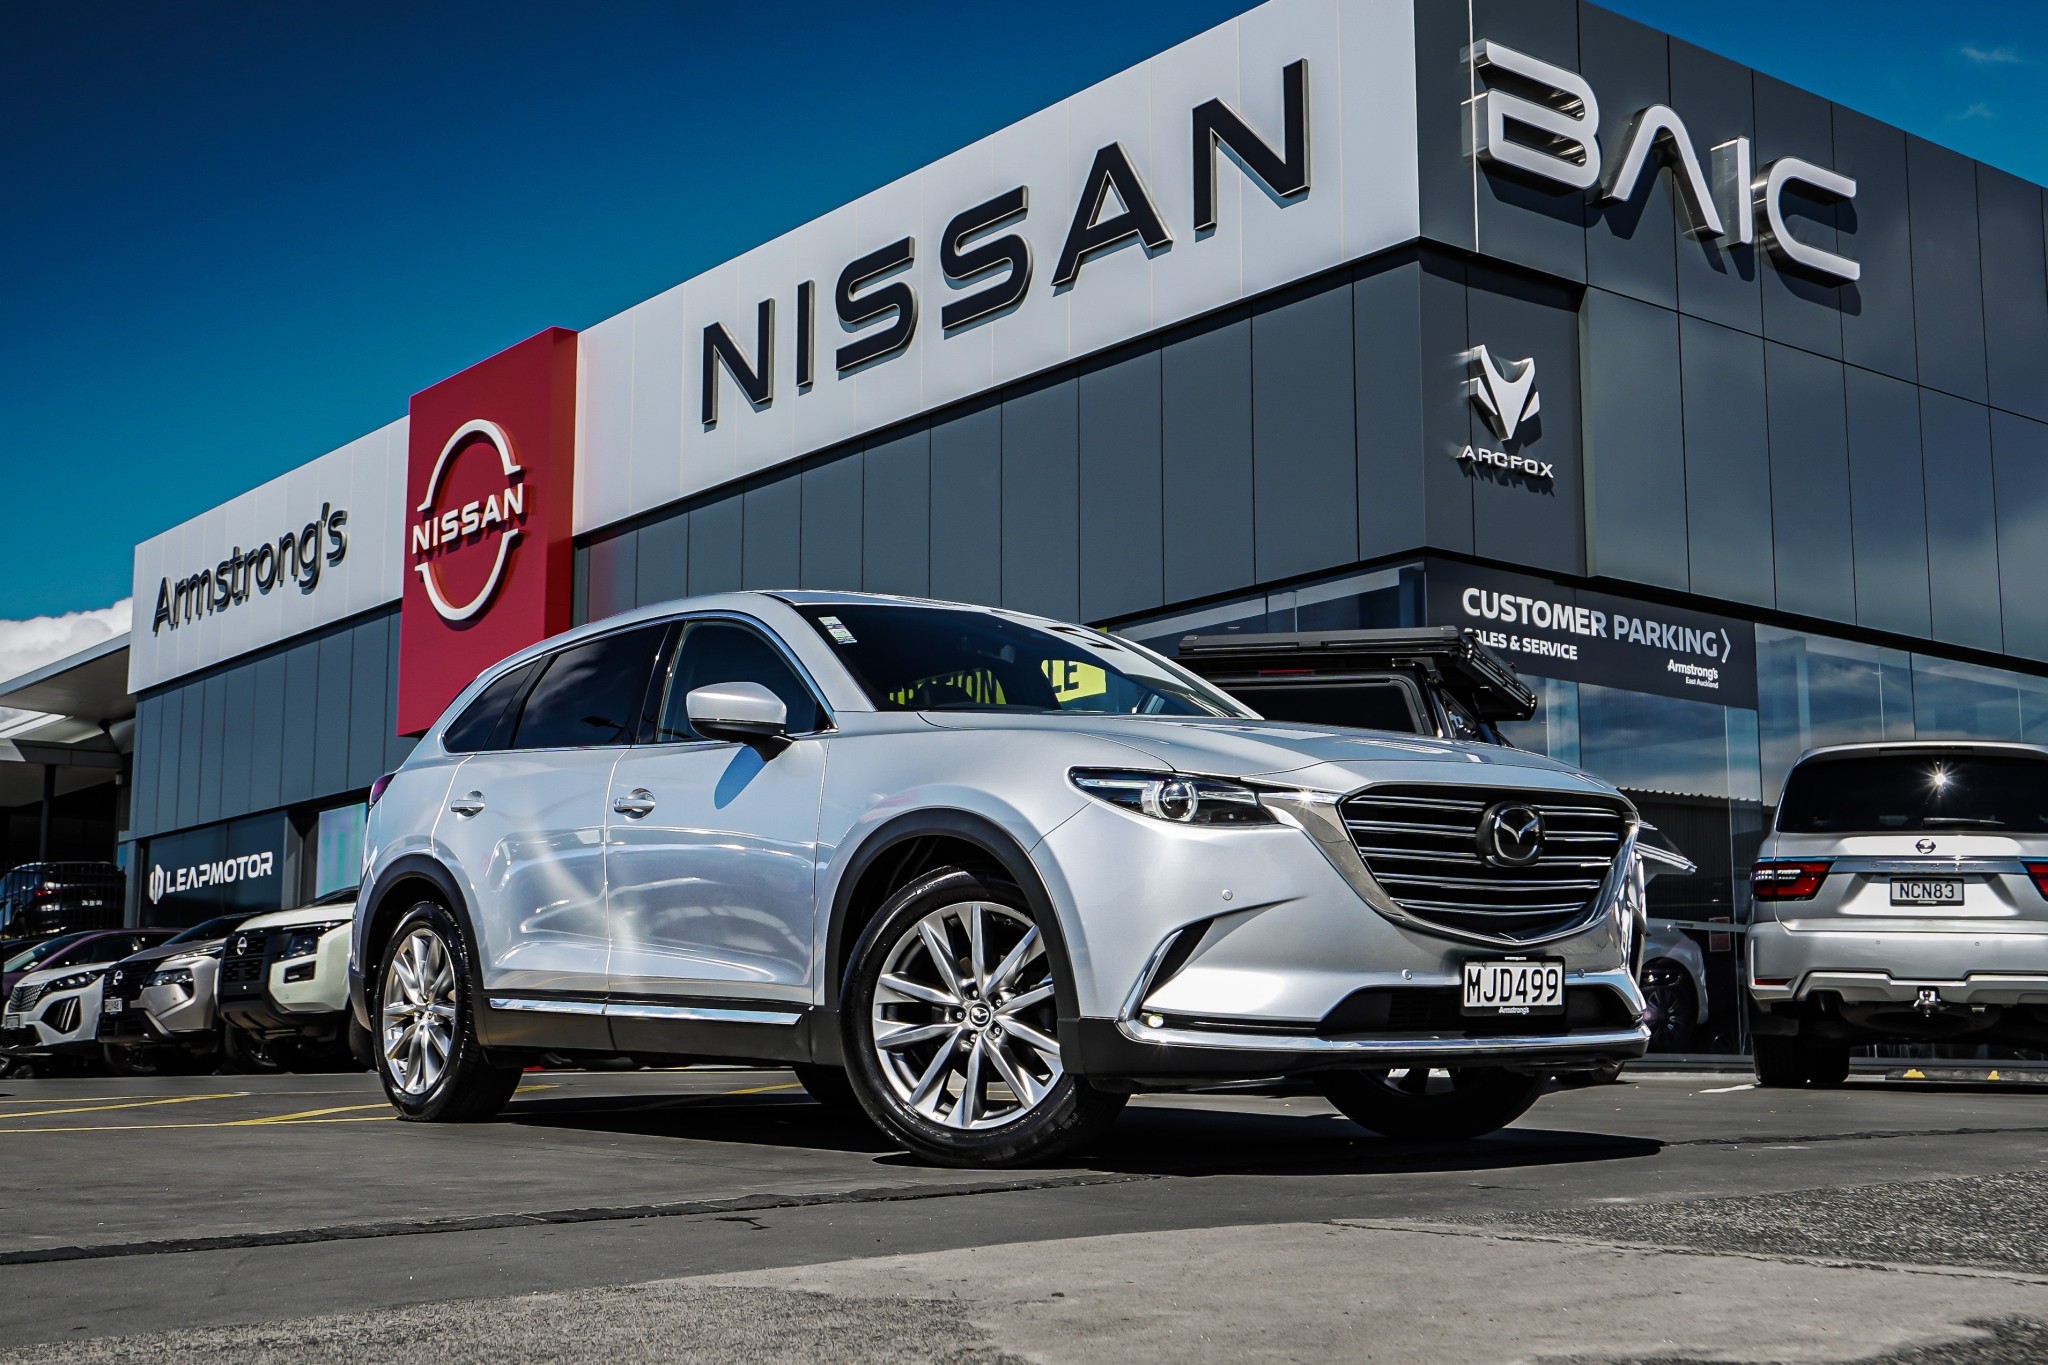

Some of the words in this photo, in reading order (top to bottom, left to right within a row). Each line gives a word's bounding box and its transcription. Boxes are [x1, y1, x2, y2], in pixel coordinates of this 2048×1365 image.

[1474, 38, 1861, 286] BAIC
[702, 58, 1311, 426] NISSAN
[1457, 445, 1554, 478] ARCFOX
[411, 483, 526, 555] NISSAN
[153, 502, 348, 632] Armstrong's
[1462, 587, 1607, 638] CUSTOMER
[1613, 615, 1718, 658] PARKING
[1509, 635, 1520, 650] &
[1522, 637, 1578, 660] SERVICE
[1667, 659, 1719, 681] Armstrong's
[166, 851, 273, 893] LEAPMOTOR
[1899, 883, 1955, 899] NCN83
[1466, 968, 1559, 1003] MJD499
